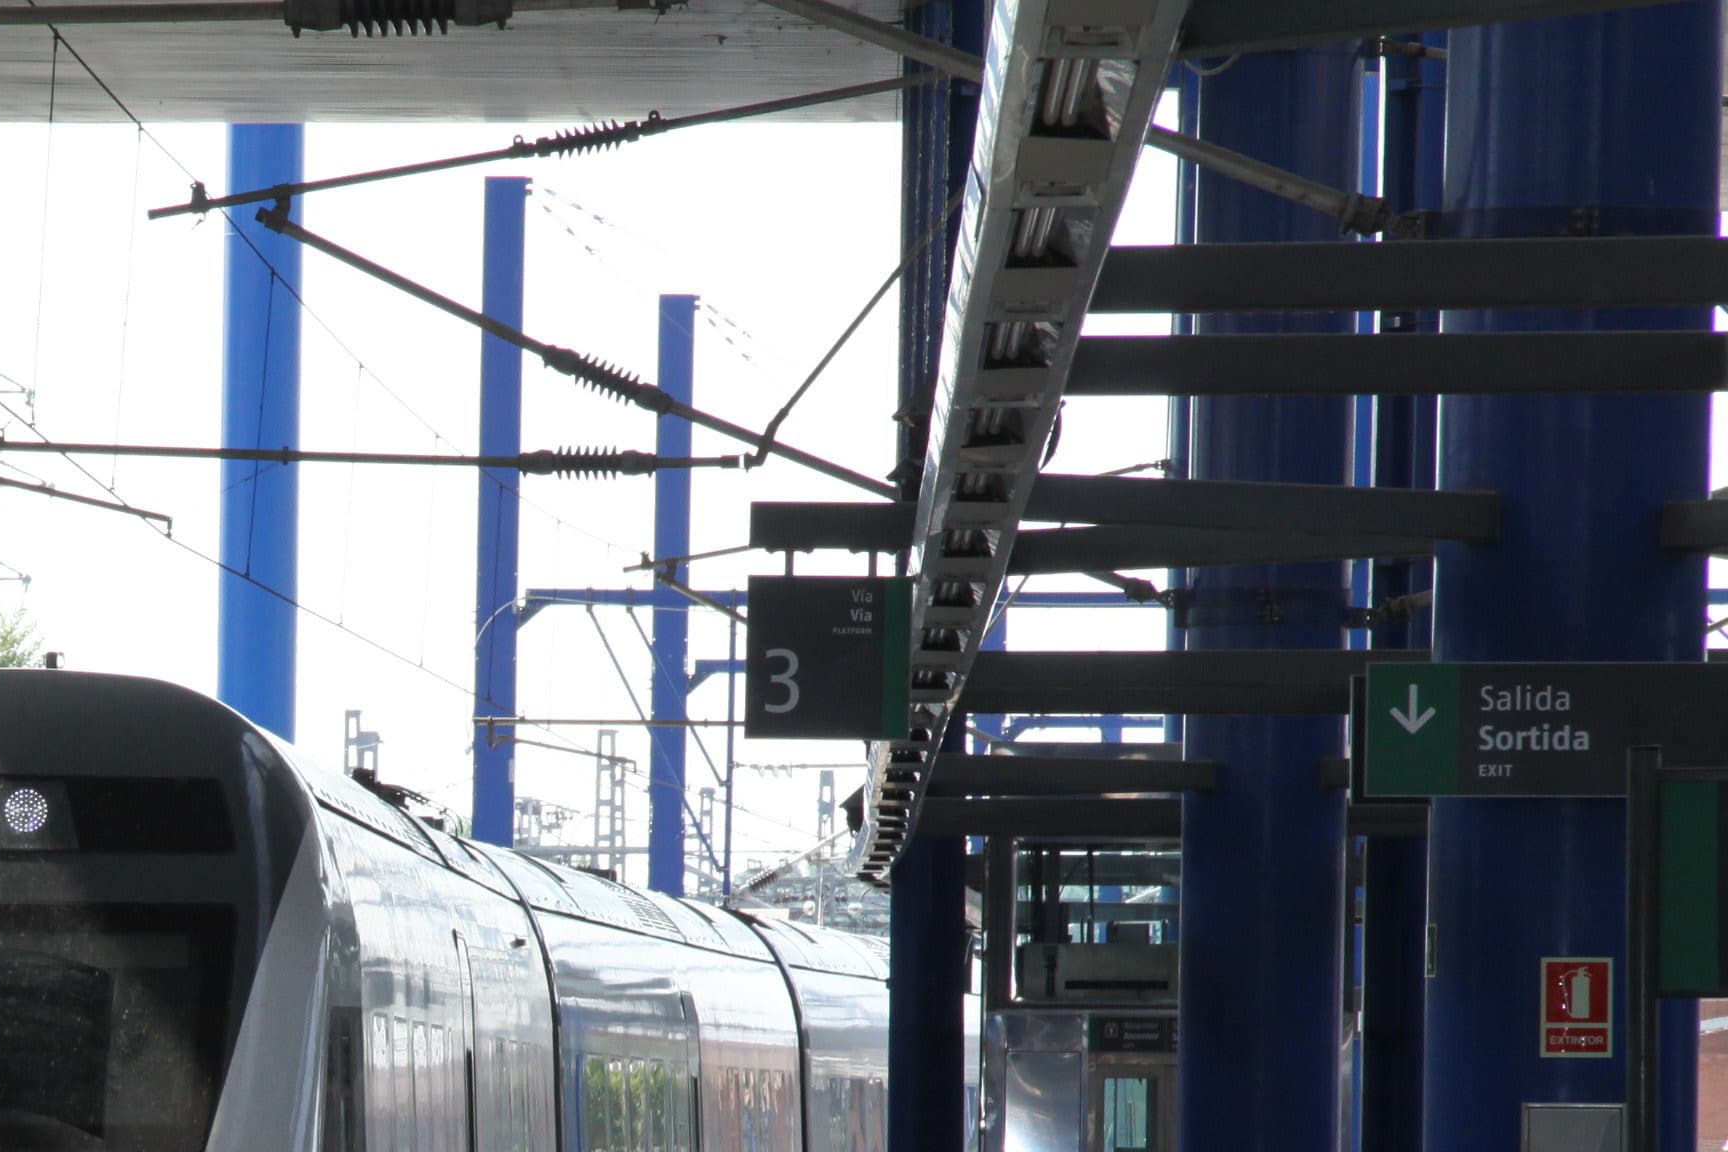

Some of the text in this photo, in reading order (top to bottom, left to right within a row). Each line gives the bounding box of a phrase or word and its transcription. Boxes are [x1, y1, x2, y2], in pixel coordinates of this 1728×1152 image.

[764, 647, 800, 714] 3
[1480, 684, 1571, 712] Salida
[1478, 724, 1590, 751] Sortida
[1478, 764, 1513, 778] EXIT
